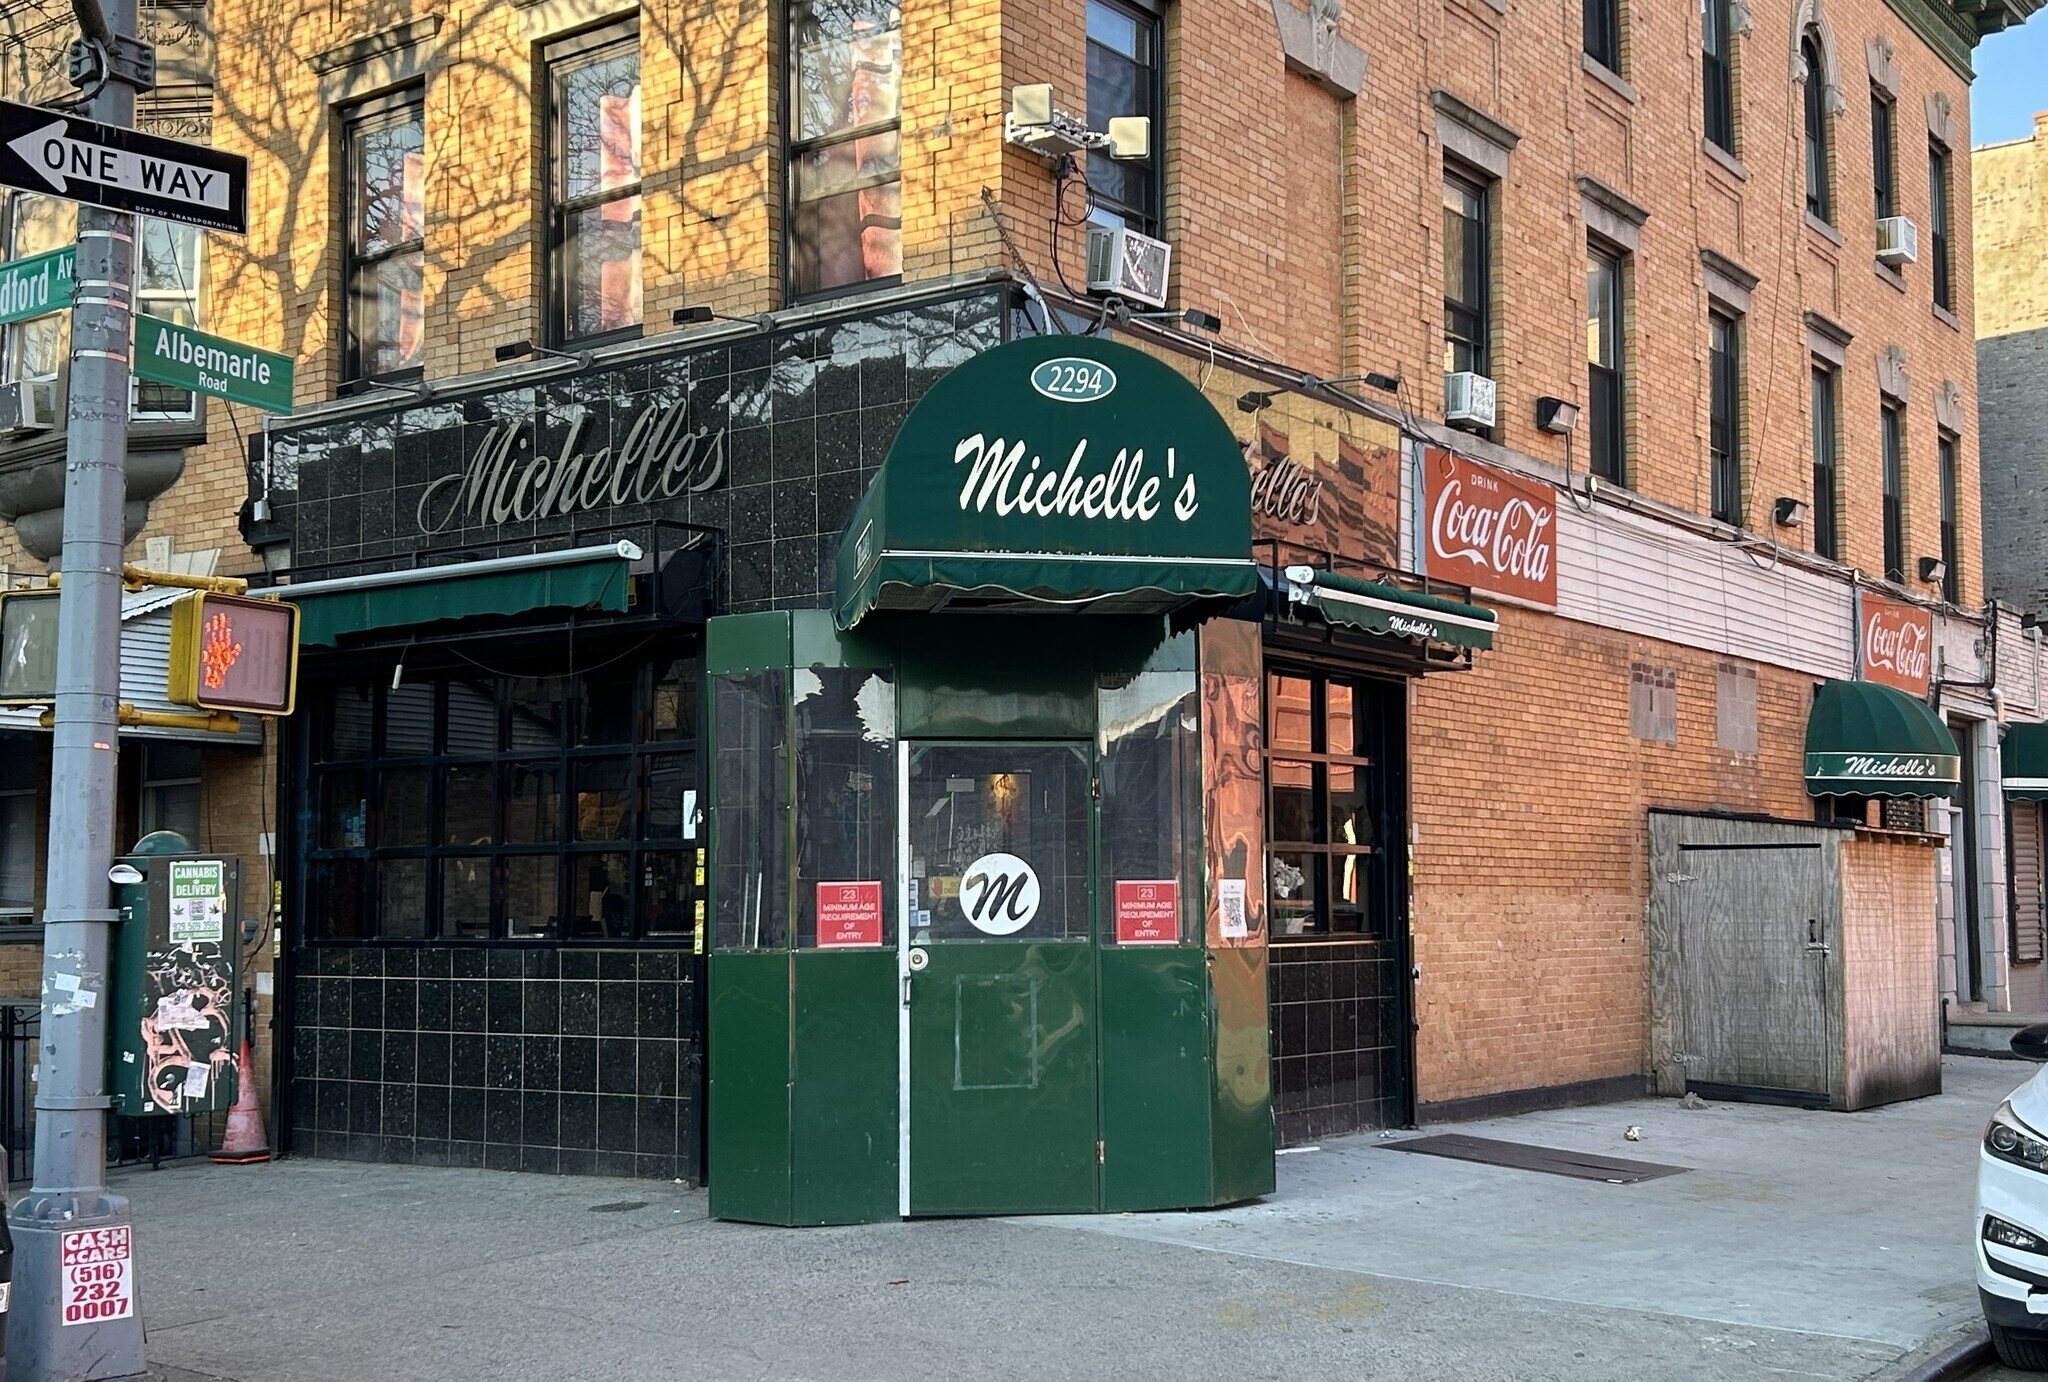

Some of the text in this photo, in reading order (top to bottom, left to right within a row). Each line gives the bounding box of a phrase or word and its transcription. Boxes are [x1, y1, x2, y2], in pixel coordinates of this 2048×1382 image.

[44, 138, 213, 201] ONE WAY
[135, 205, 155, 214] DEPT
[171, 212, 239, 231] TRANSPORTATION
[57, 253, 73, 280] Av
[155, 327, 271, 385] Albemarle
[198, 371, 228, 392] Road
[1047, 365, 1103, 395] 2294
[417, 397, 725, 535] Michelle's
[954, 432, 1199, 522] Michelle's
[1244, 440, 1323, 526] elle's
[1470, 473, 1500, 493] DRINK
[1388, 615, 1438, 638] Michelle's
[1844, 755, 1937, 777] Michelle's
[174, 866, 218, 879] CANNABIS
[175, 883, 217, 896] DELIVERY
[842, 889, 856, 900] 23
[966, 871, 1030, 922] M
[1140, 887, 1154, 898] 23
[822, 902, 876, 912] MINIMUM AGE
[1120, 910, 1175, 919] REQUIREMENT
[1121, 901, 1173, 909] MINIMUM AGE
[821, 912, 878, 921] REQUIREMENT
[843, 922, 856, 930] OF
[1141, 920, 1153, 928] OF
[836, 931, 863, 940] ENTRY
[1134, 929, 1160, 937] ENTRY
[70, 1261, 124, 1285] (516)
[73, 1281, 120, 1303] 232
[66, 1297, 129, 1322] 0007
